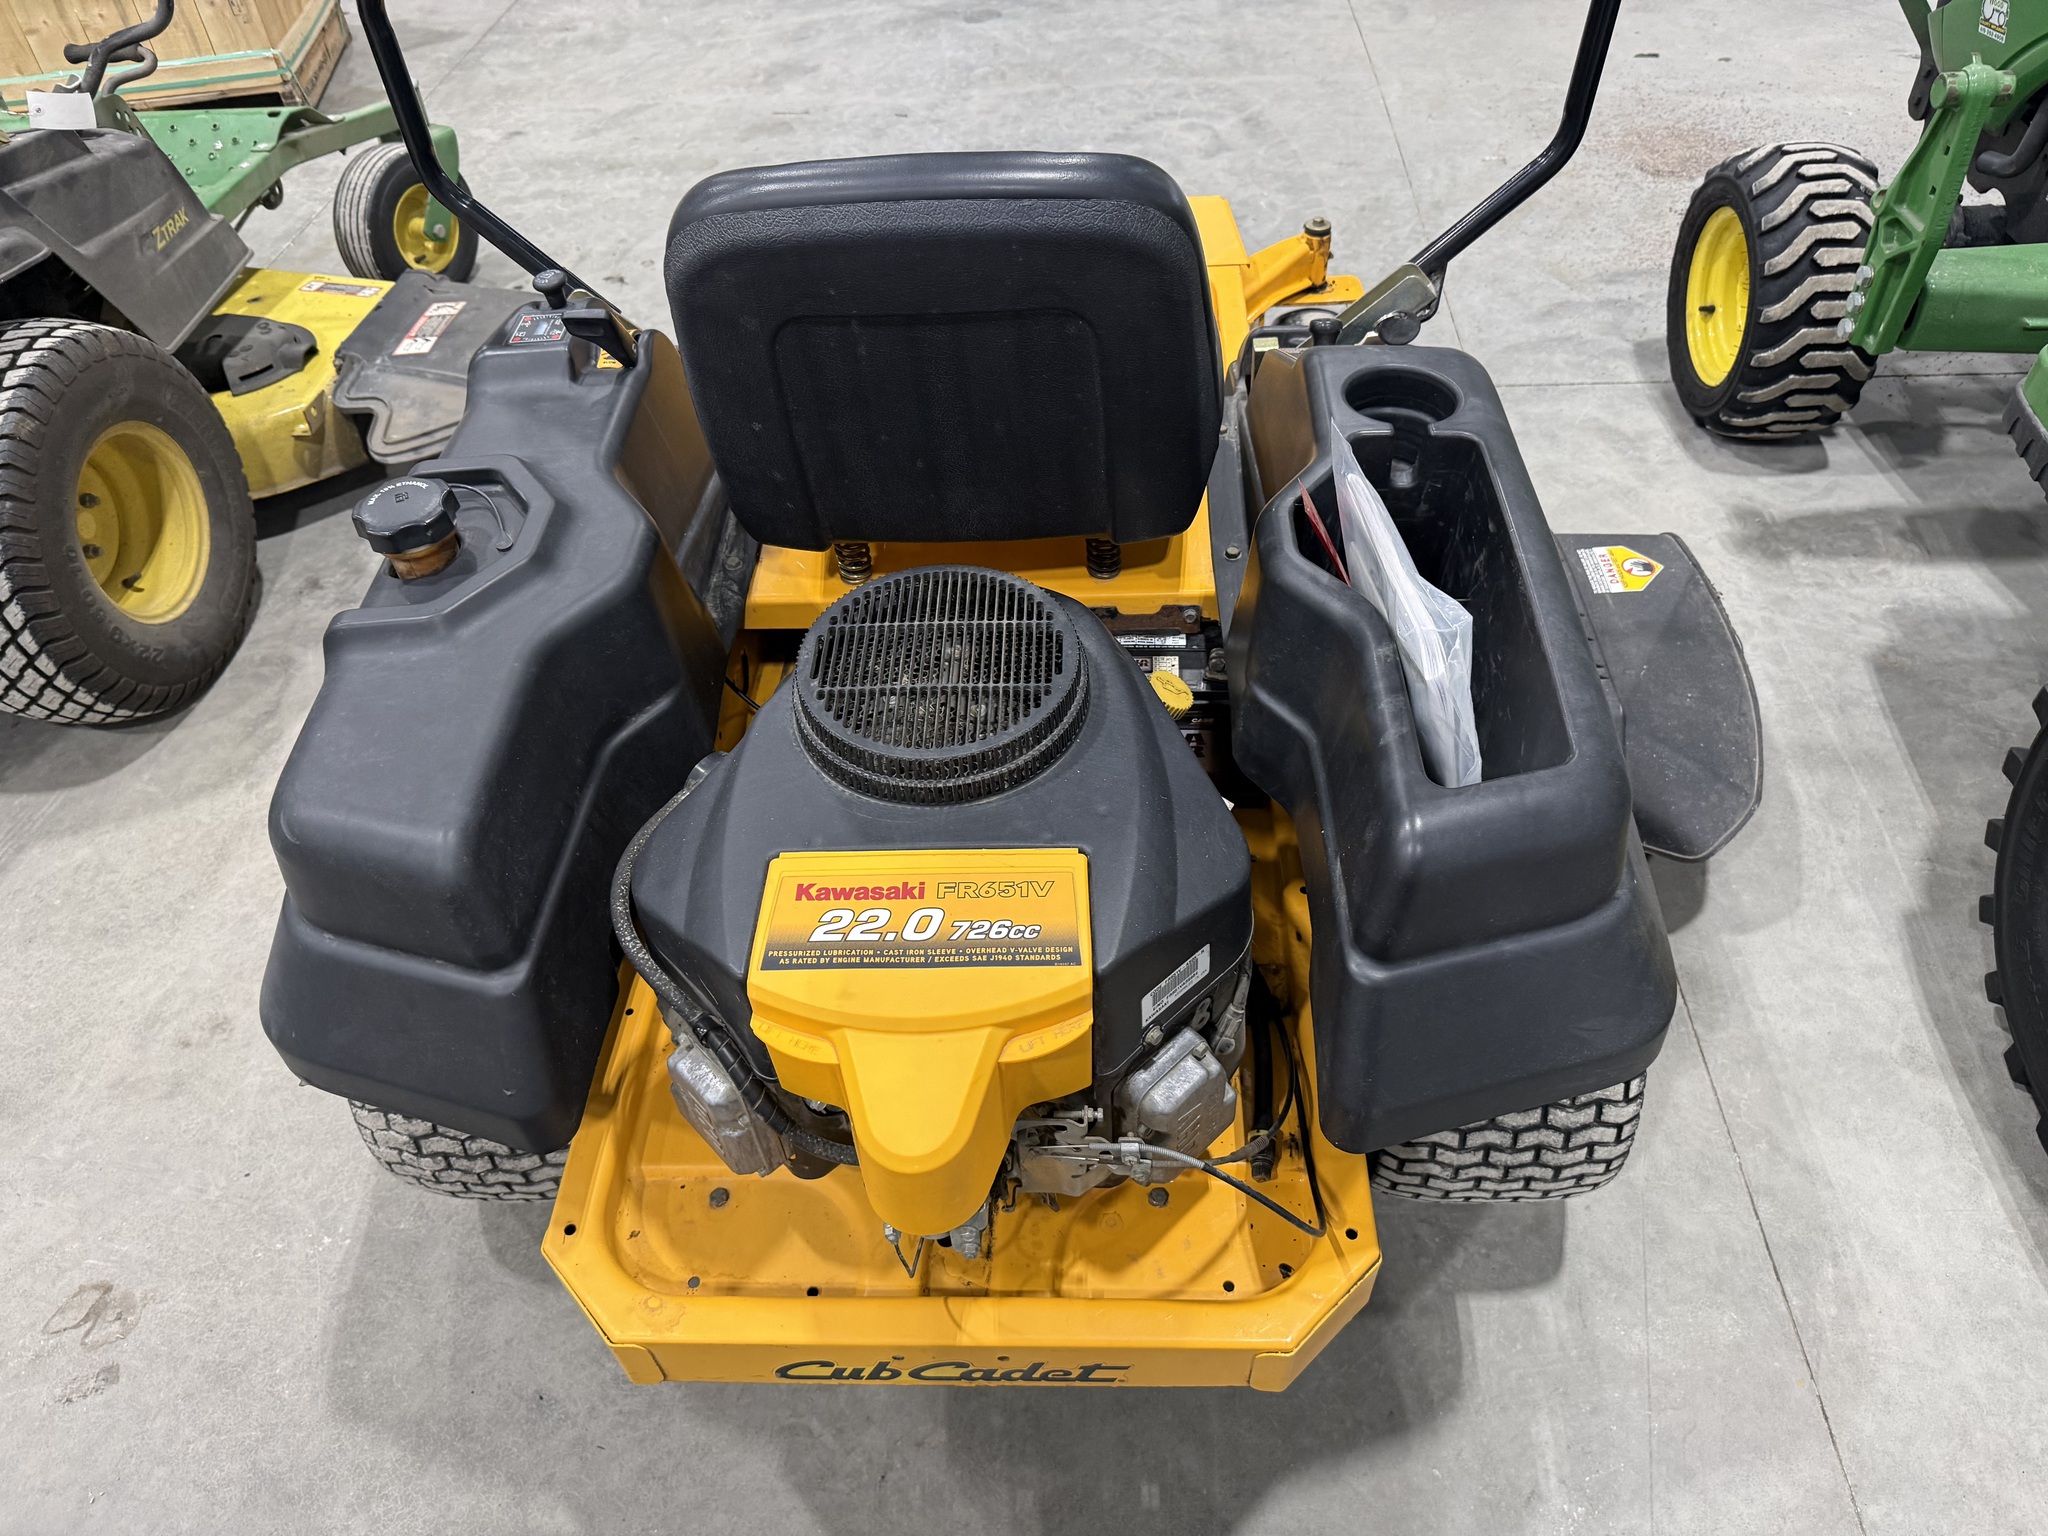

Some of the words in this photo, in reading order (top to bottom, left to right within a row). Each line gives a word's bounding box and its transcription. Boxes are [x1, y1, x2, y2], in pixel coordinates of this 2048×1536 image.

[151, 206, 190, 252] ZTRAK
[1598, 554, 1620, 584] DANGER
[794, 882, 926, 902] Kawasaki
[937, 880, 1056, 899] FR651V
[807, 906, 946, 942] 22.0
[947, 920, 1042, 941] 726cc
[768, 950, 820, 958] PRESSURIZED
[775, 1360, 903, 1380] Cub
[908, 1361, 1131, 1382] Cadet
